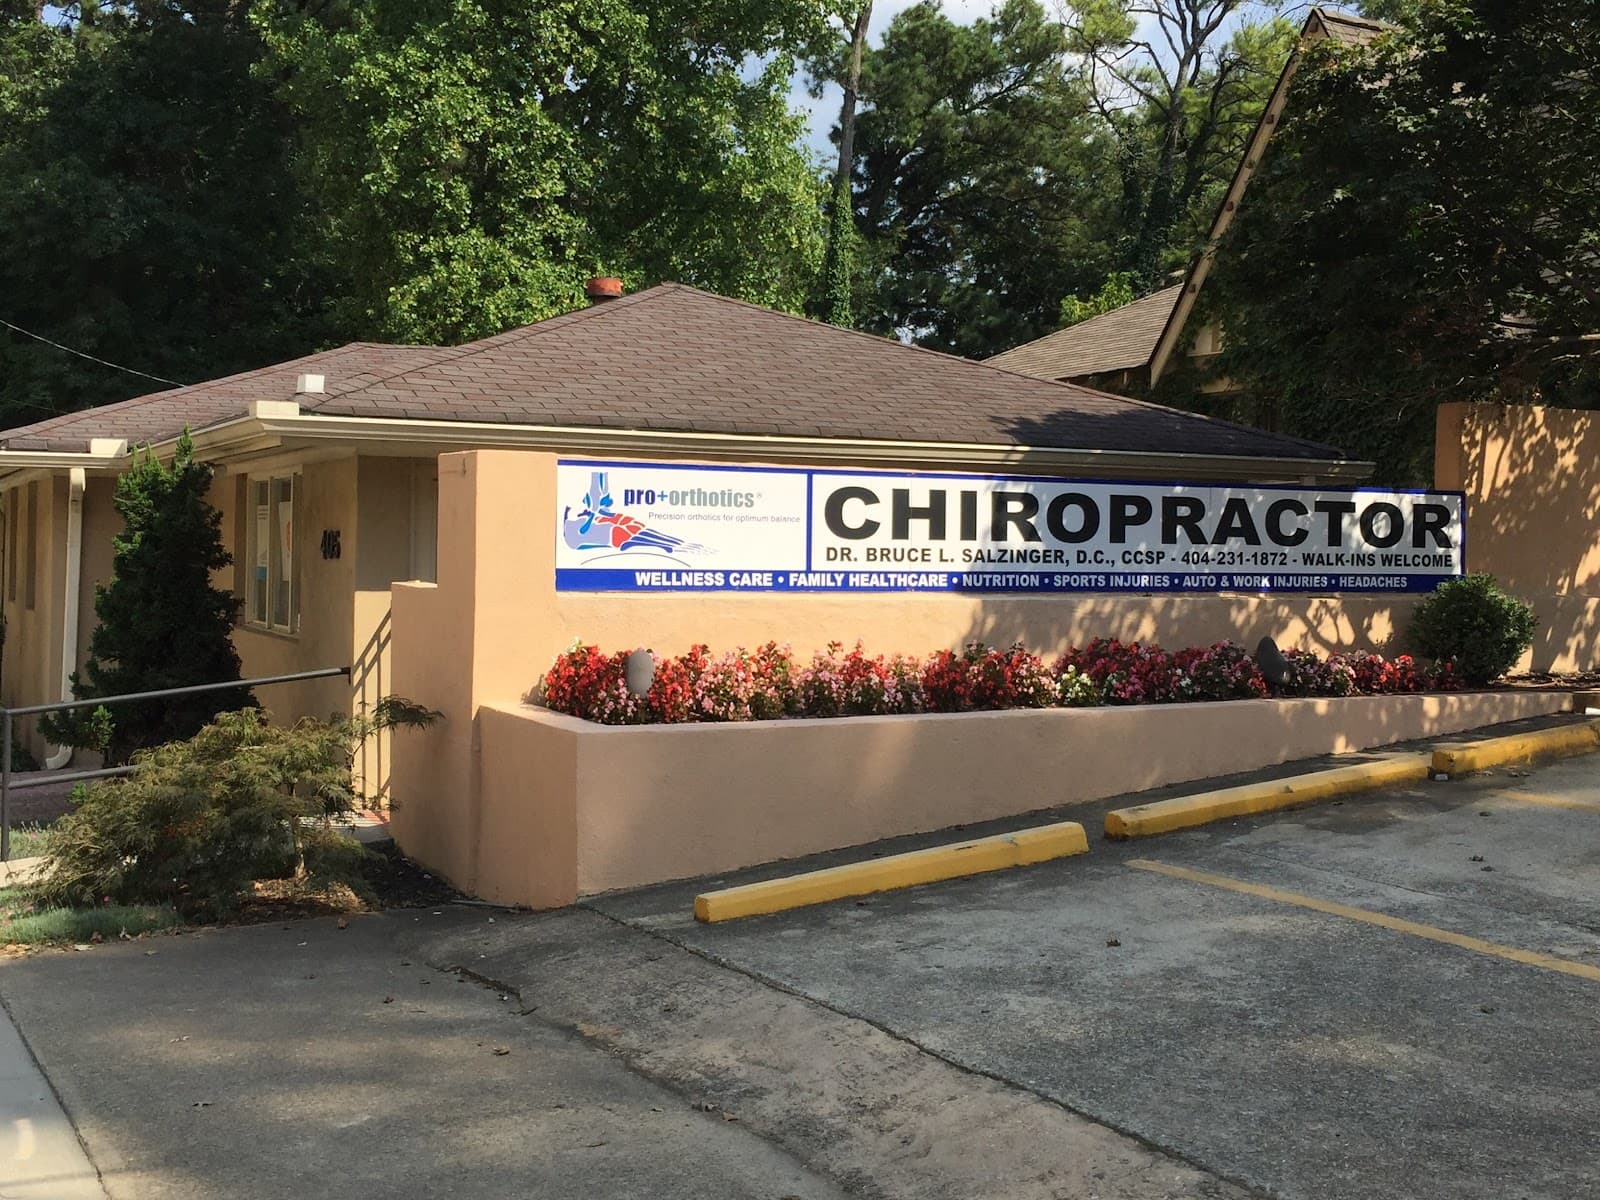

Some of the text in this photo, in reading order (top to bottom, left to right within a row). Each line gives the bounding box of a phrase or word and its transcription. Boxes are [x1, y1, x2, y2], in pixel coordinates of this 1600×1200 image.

[648, 511, 801, 524] Precision orthotics for optimum balance
[824, 486, 1453, 549] CHIROPRACTOR
[826, 547, 858, 562] DR.
[866, 547, 931, 562] BRUCE
[939, 548, 954, 563] L.
[962, 548, 1070, 566] SALZINGER,
[1076, 550, 1115, 567] D.C.,
[1121, 551, 1165, 565] CCSP
[1181, 551, 1288, 566] 404-231-1872
[1302, 552, 1376, 567] WALK-INS
[1380, 553, 1453, 568] WELCOME
[635, 572, 1408, 588] WELLNESS CARE FAMILY HEALTHCARE NUTRITION SPORTS INJURIES AUTO & WORK INJURIES HEADACHES
